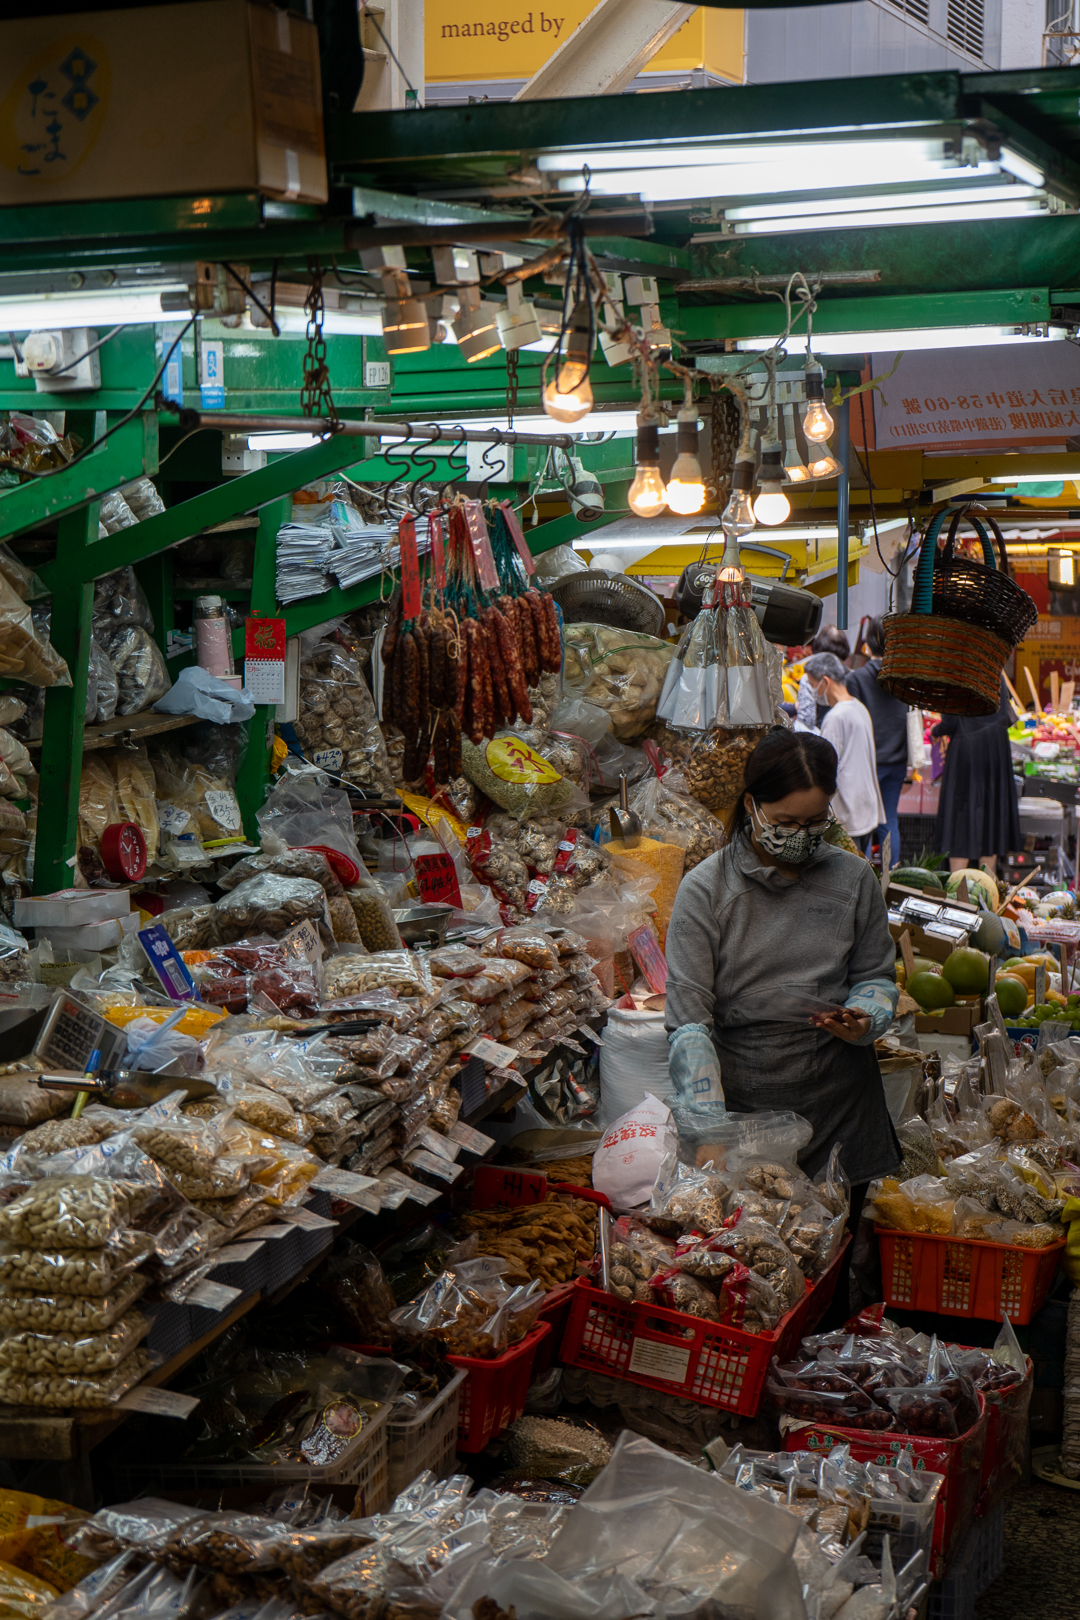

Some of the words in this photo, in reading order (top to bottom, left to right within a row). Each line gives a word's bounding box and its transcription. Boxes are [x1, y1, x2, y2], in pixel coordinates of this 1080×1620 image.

[441, 14, 534, 42] managed
[541, 12, 565, 37] by
[378, 367, 389, 383] 126
[254, 625, 276, 649] 福
[603, 1126, 657, 1149] 玫瑰花
